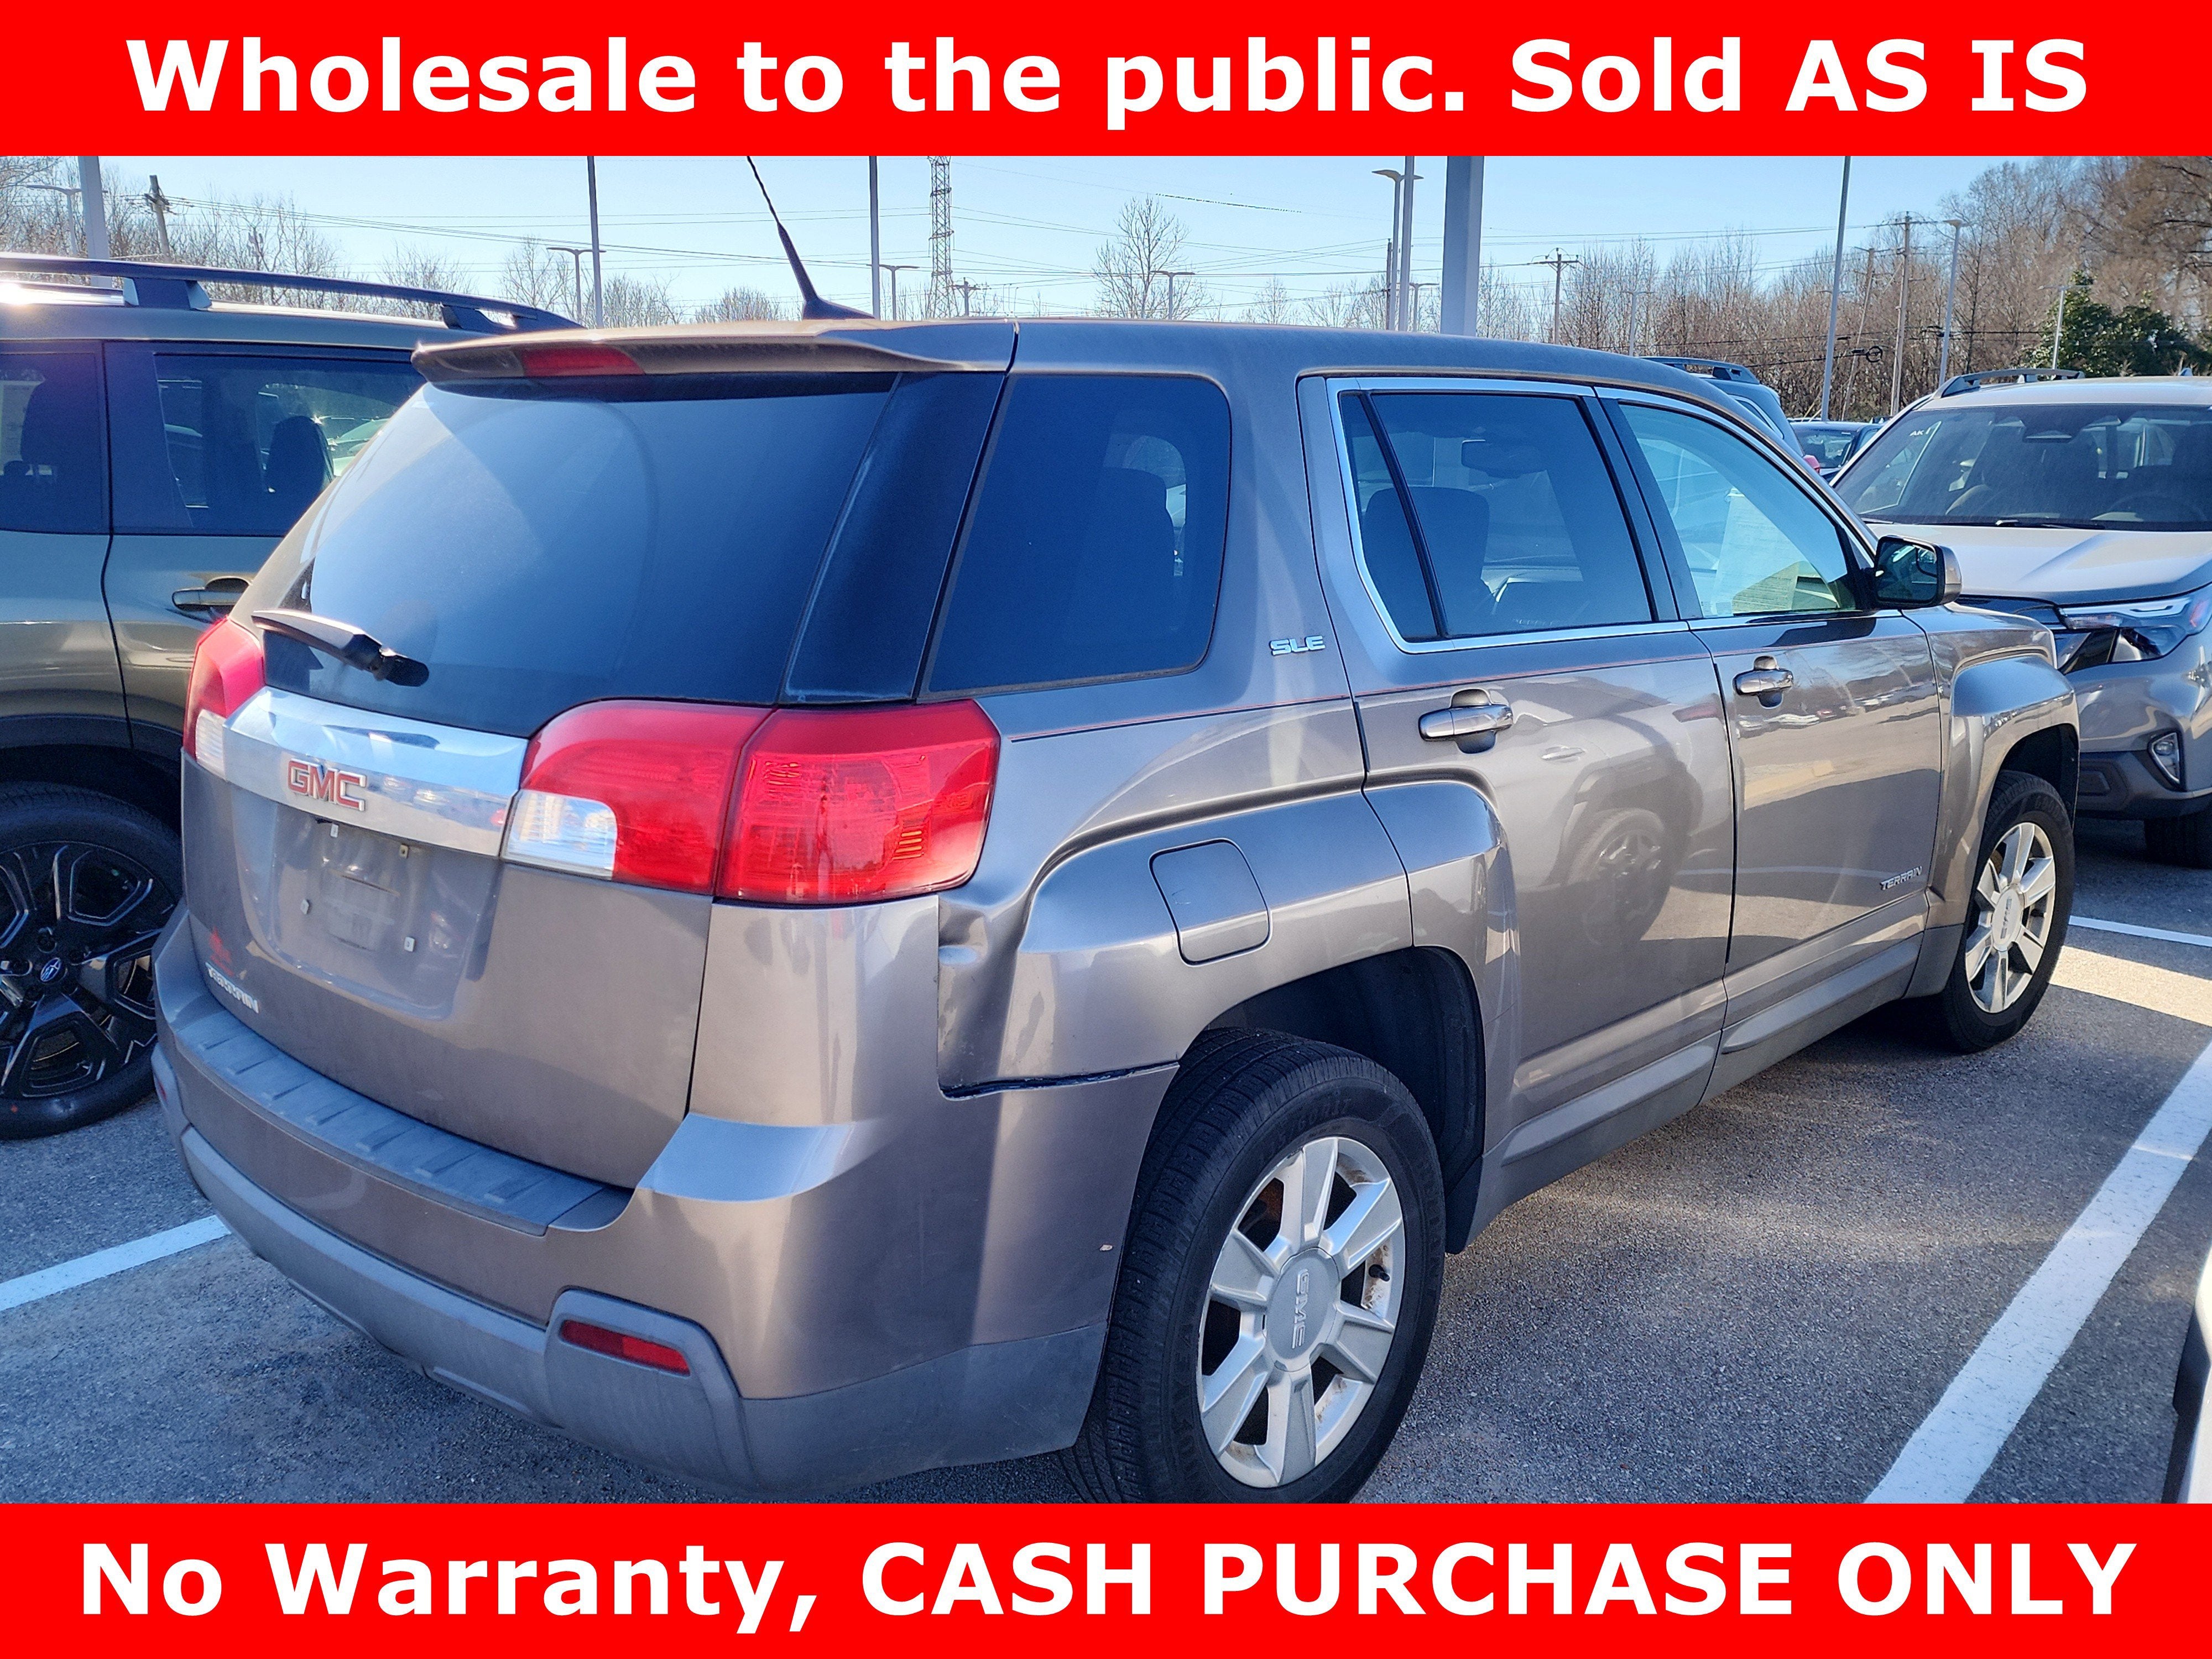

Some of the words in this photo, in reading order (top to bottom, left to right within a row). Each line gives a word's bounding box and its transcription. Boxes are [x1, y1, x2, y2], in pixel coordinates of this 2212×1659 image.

[1269, 634, 1326, 656] SLE
[287, 758, 367, 812] GMC
[1880, 865, 1923, 890] TERRAIN
[205, 962, 259, 1014] TERRAIN
[1291, 1269, 1310, 1349] GMC
